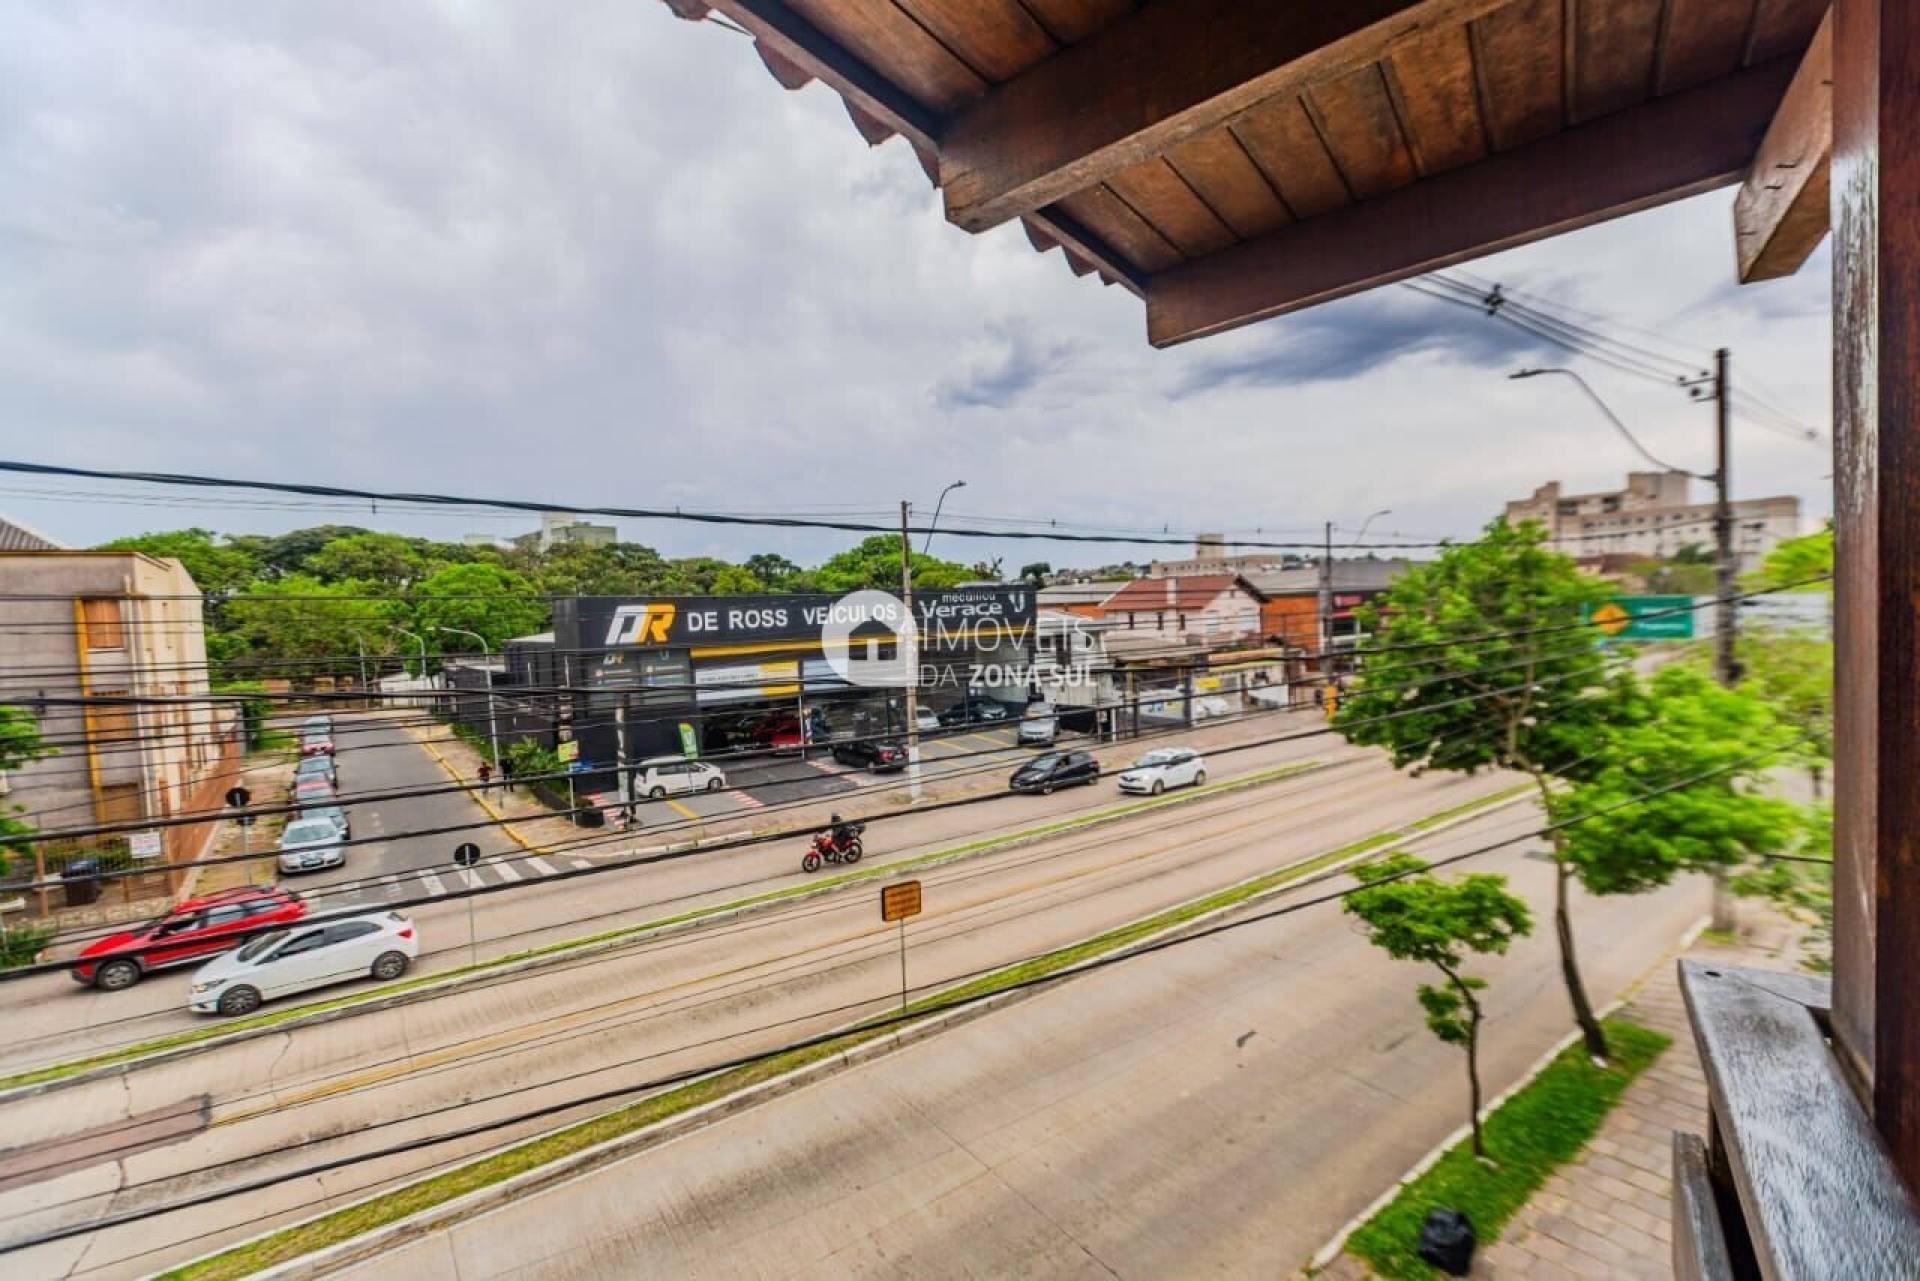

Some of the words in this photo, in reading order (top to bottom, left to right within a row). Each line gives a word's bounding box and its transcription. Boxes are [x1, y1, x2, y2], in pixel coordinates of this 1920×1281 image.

[687, 611, 720, 631] DE
[728, 608, 788, 630] ROSS
[803, 602, 898, 625] VEÍCULOS
[918, 599, 1003, 618] Verace
